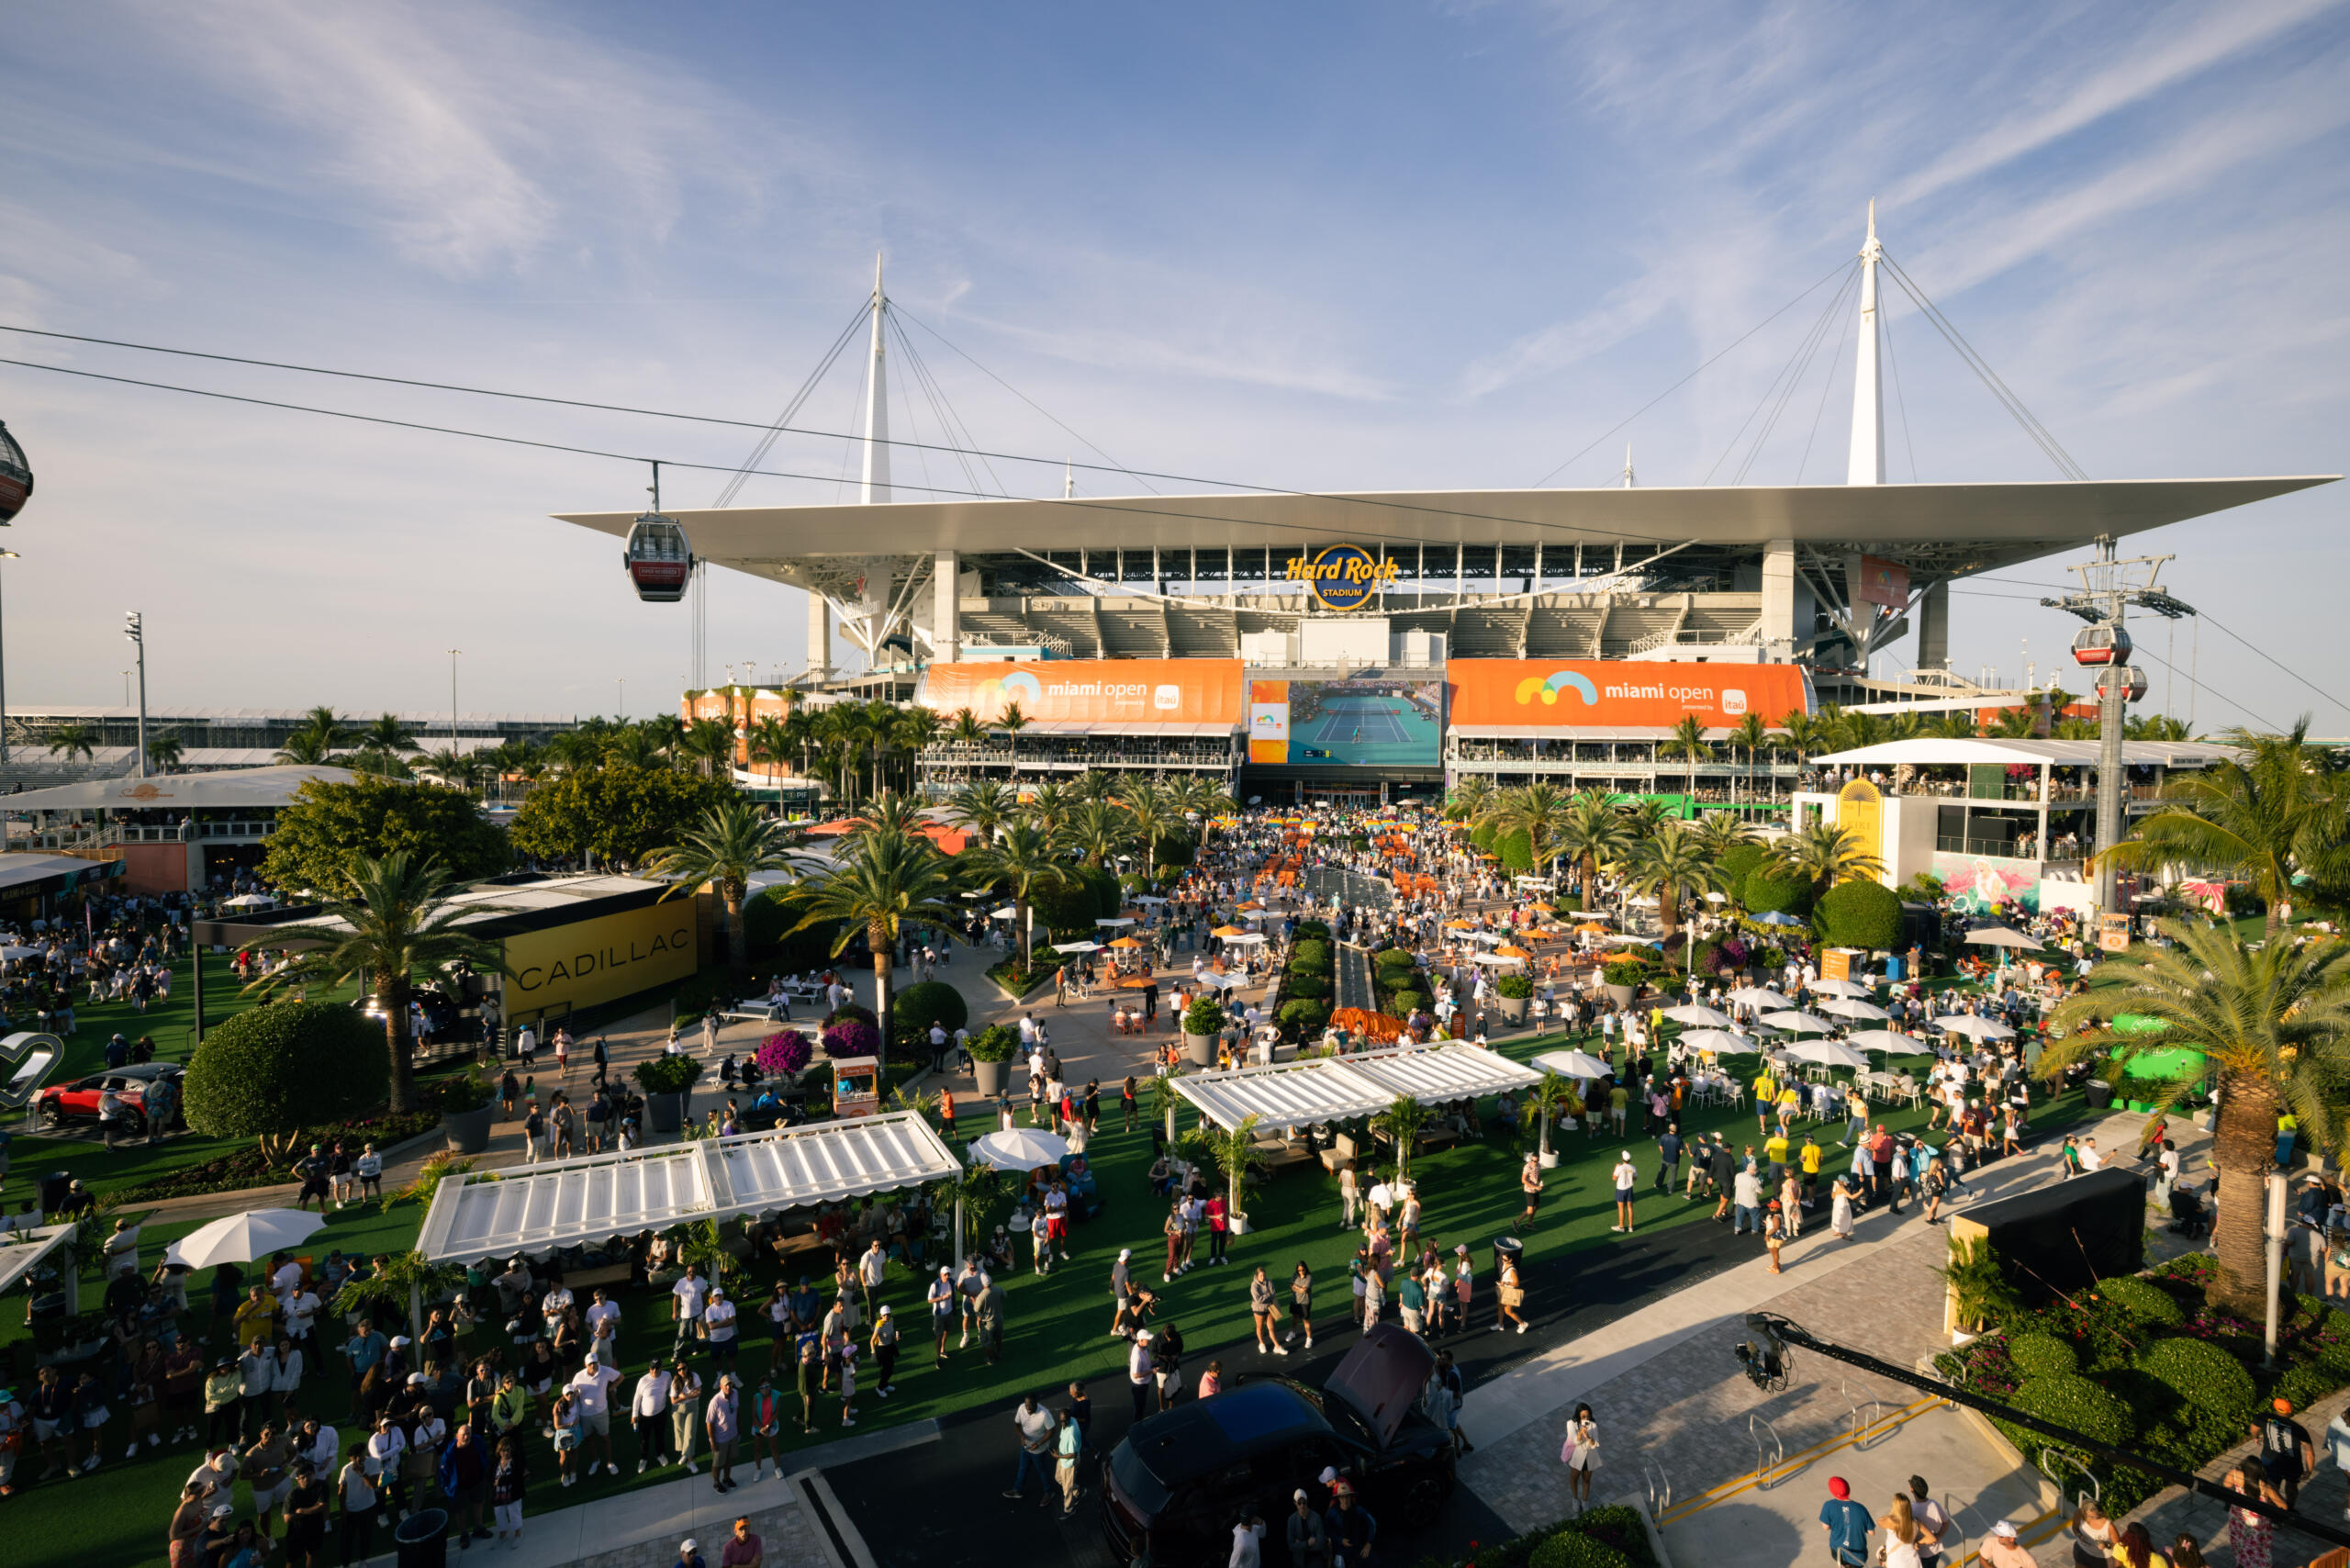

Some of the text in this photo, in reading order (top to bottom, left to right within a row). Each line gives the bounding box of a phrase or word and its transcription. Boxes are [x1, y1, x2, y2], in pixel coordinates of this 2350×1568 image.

[1286, 556, 1399, 585] Hard Rock
[1323, 588, 1363, 597] STADIUM
[1048, 680, 1147, 700] miami open
[1605, 682, 1714, 702] miami open
[519, 928, 688, 991] CADILLAC
